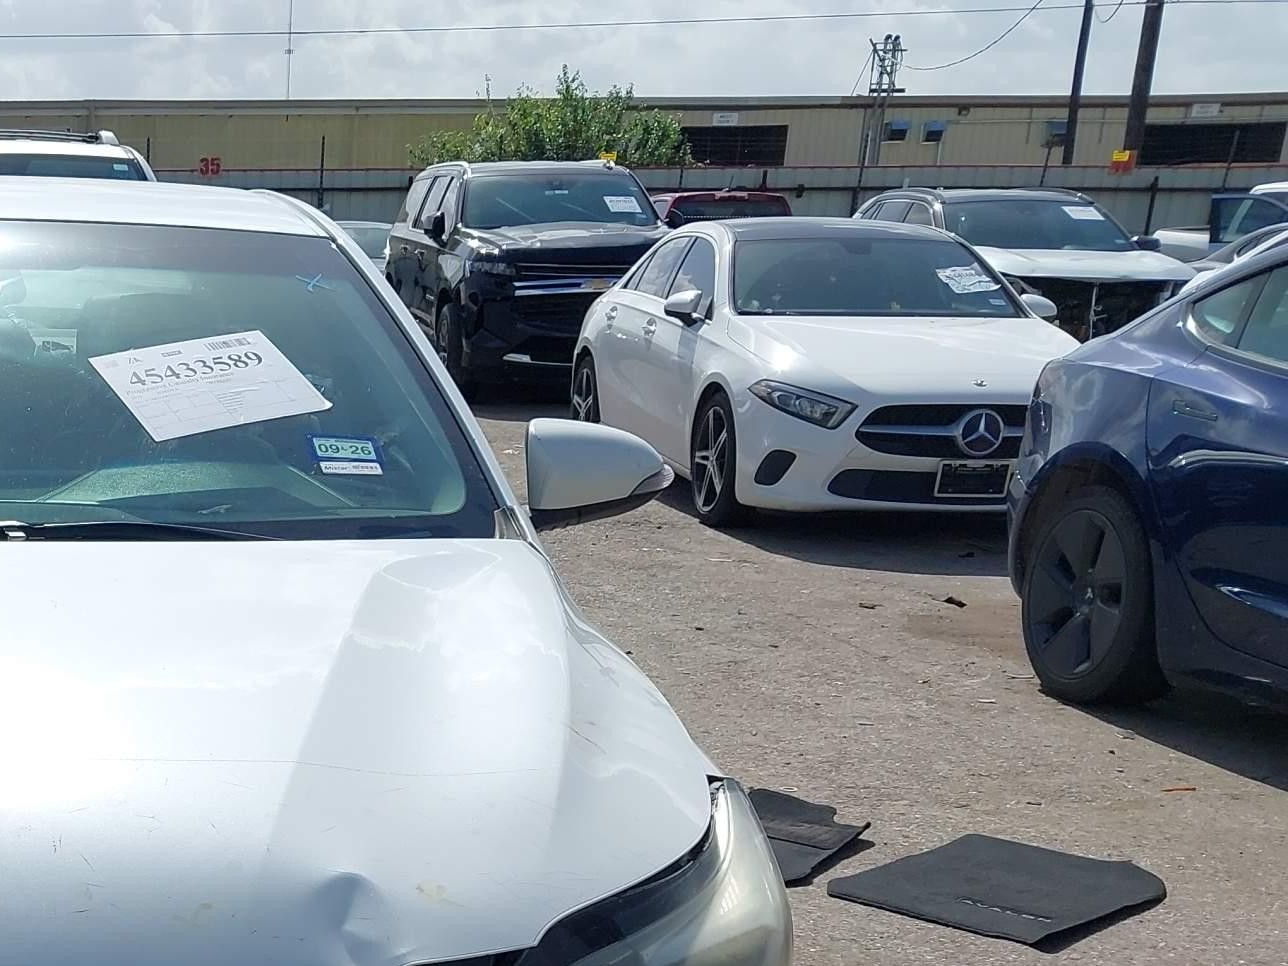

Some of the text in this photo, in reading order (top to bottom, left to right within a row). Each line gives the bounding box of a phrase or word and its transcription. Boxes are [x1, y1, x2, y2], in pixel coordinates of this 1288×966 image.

[199, 157, 222, 176] 35
[129, 351, 263, 386] 45433589
[317, 443, 372, 456] 09 26
